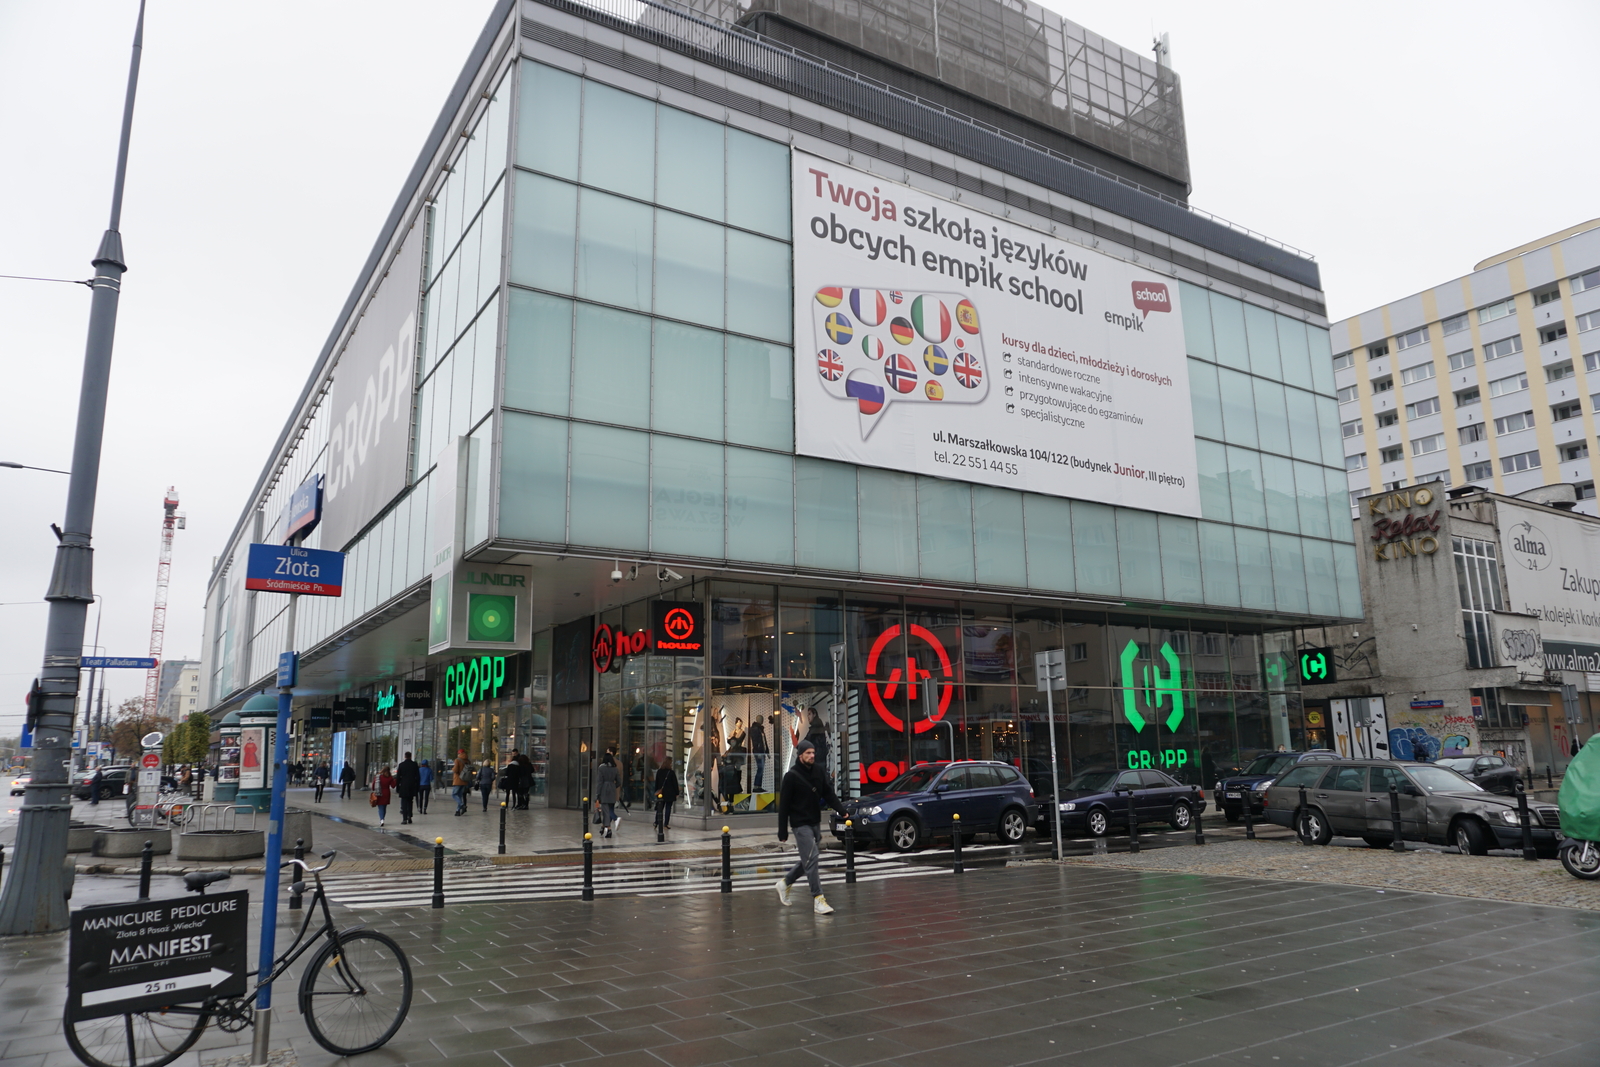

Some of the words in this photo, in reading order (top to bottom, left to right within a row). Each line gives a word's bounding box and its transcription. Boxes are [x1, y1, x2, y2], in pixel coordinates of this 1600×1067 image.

[809, 167, 897, 222] Twoja
[903, 206, 986, 250] szkoła
[991, 226, 1088, 281] języków
[810, 212, 916, 266] obcych
[922, 250, 1004, 292] empik
[1008, 275, 1083, 315] school
[1136, 288, 1167, 303] school
[1104, 311, 1144, 333] empik
[1002, 332, 1030, 353] kursy
[1031, 341, 1046, 355] dla
[1048, 345, 1079, 365] dzieci,
[1080, 355, 1125, 377] młodzieży
[1126, 365, 1130, 376] i
[1131, 367, 1172, 387] dorosłych
[1017, 356, 1073, 378] standardowe
[1073, 371, 1101, 385] roczne
[1018, 371, 1069, 393] intensywne
[1069, 386, 1112, 403] wakacyjne
[326, 310, 414, 503] CROPP
[1020, 390, 1087, 413] przygotowujące
[1088, 404, 1098, 416] do
[1099, 408, 1144, 425] egzaminów
[1020, 407, 1085, 428] specjalistyczne
[933, 430, 946, 443] ul.
[947, 433, 1028, 458] Marszałkowska
[1029, 448, 1069, 466] 104/122
[1070, 456, 1112, 473] (budynek
[1113, 463, 1148, 481] Junior,
[1148, 470, 1157, 482] III
[1158, 472, 1185, 488] piętro)
[934, 451, 951, 464] tel.
[952, 453, 967, 467] 22
[968, 456, 988, 470] 551
[990, 460, 1004, 472] 44
[1005, 463, 1018, 476] 55
[1369, 487, 1434, 517] KINO
[1371, 510, 1440, 540] Relax
[290, 548, 308, 558] Ulica
[1374, 536, 1439, 561] KINO
[1513, 534, 1547, 557] alma
[275, 557, 320, 578] Złota
[1527, 558, 1538, 571] 24
[266, 578, 310, 591] Śródmieście
[313, 583, 324, 592] Pn.
[459, 571, 526, 588] JUNIOR
[1560, 567, 1600, 602] Zakup
[1543, 604, 1576, 627] kolejek
[1576, 609, 1580, 624] i
[657, 640, 701, 650] house
[85, 658, 103, 666] Teatr
[105, 658, 138, 667] Palladium
[446, 656, 505, 707] CROPP
[406, 690, 431, 700] empik
[82, 909, 163, 932] MANICURE
[170, 899, 237, 920] PEDICURE
[115, 926, 138, 939] Złota
[139, 927, 146, 936] 8
[147, 923, 170, 935] Pasaż
[109, 933, 213, 966] MANIFEST
[145, 982, 161, 994] 25
[164, 982, 176, 990] m
